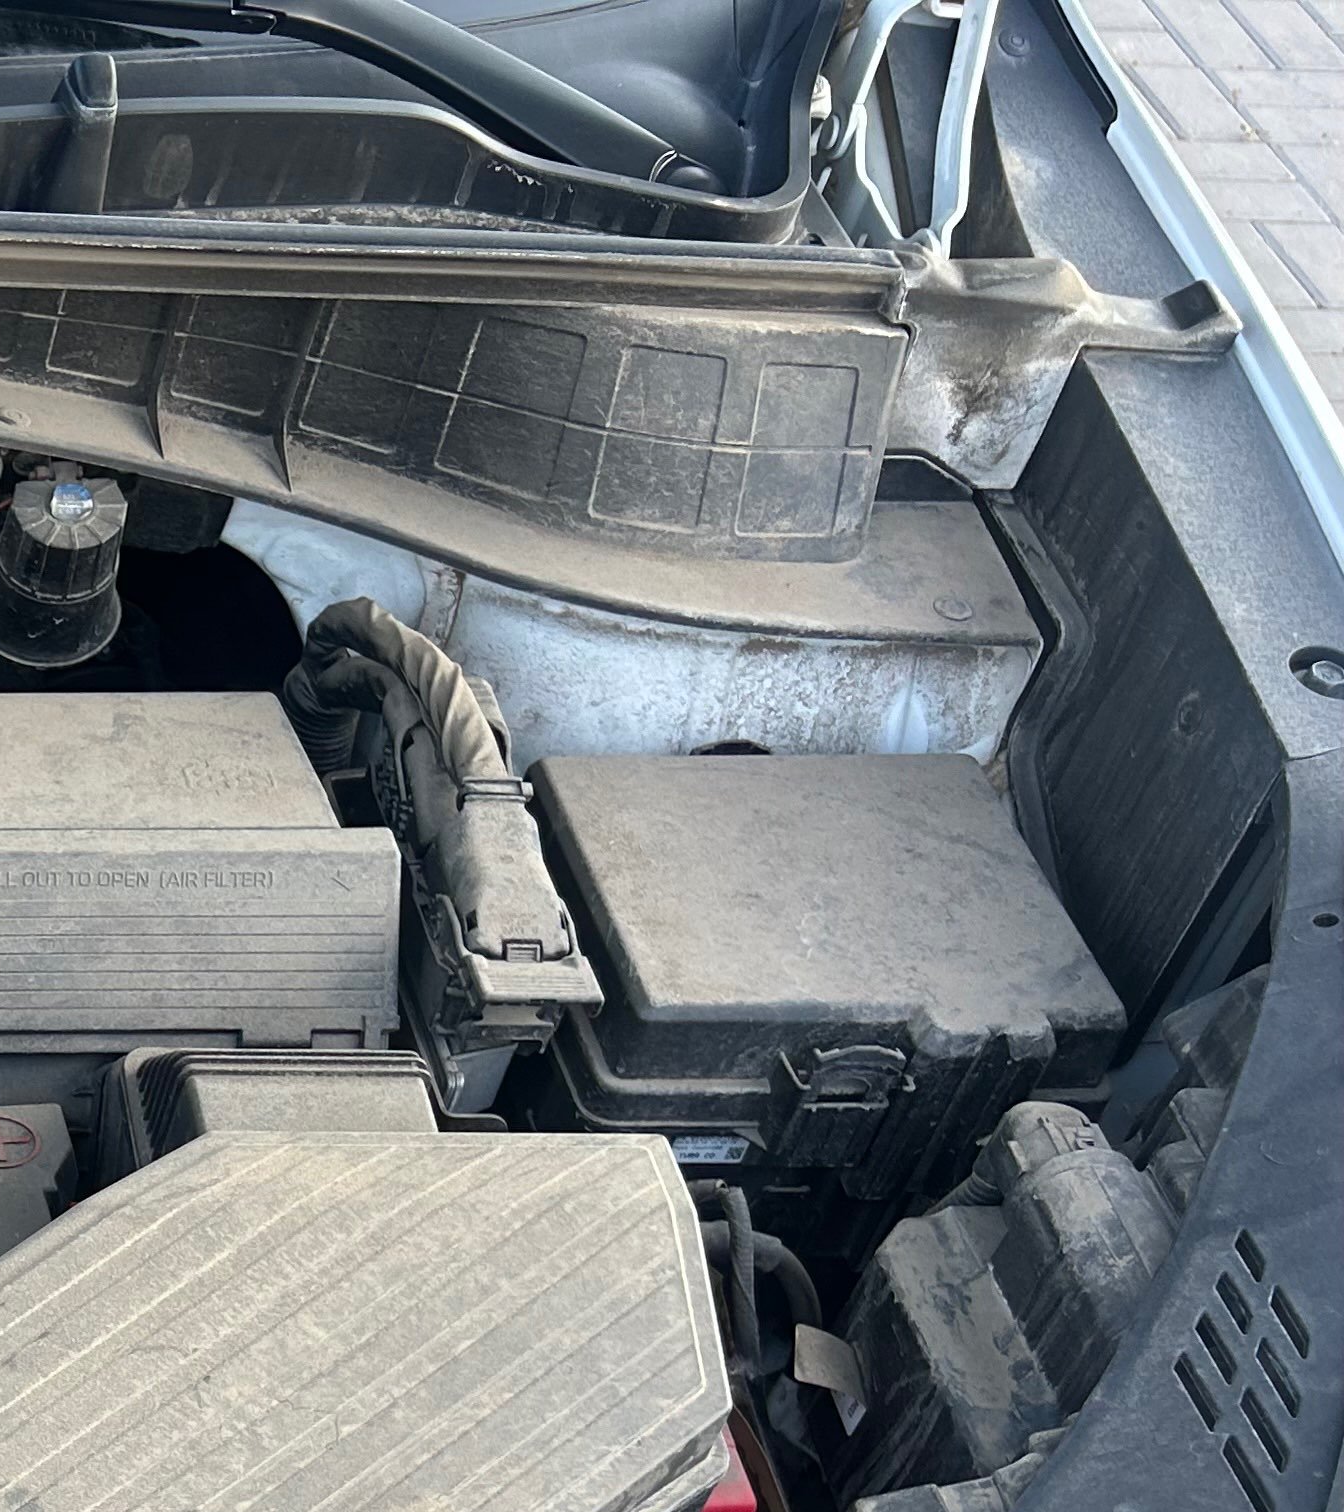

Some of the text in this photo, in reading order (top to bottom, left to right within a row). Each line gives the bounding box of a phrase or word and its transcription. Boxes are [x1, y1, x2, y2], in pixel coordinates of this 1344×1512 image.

[21, 870, 63, 888] OUT
[66, 870, 92, 888] TO
[96, 870, 150, 888] OPEN
